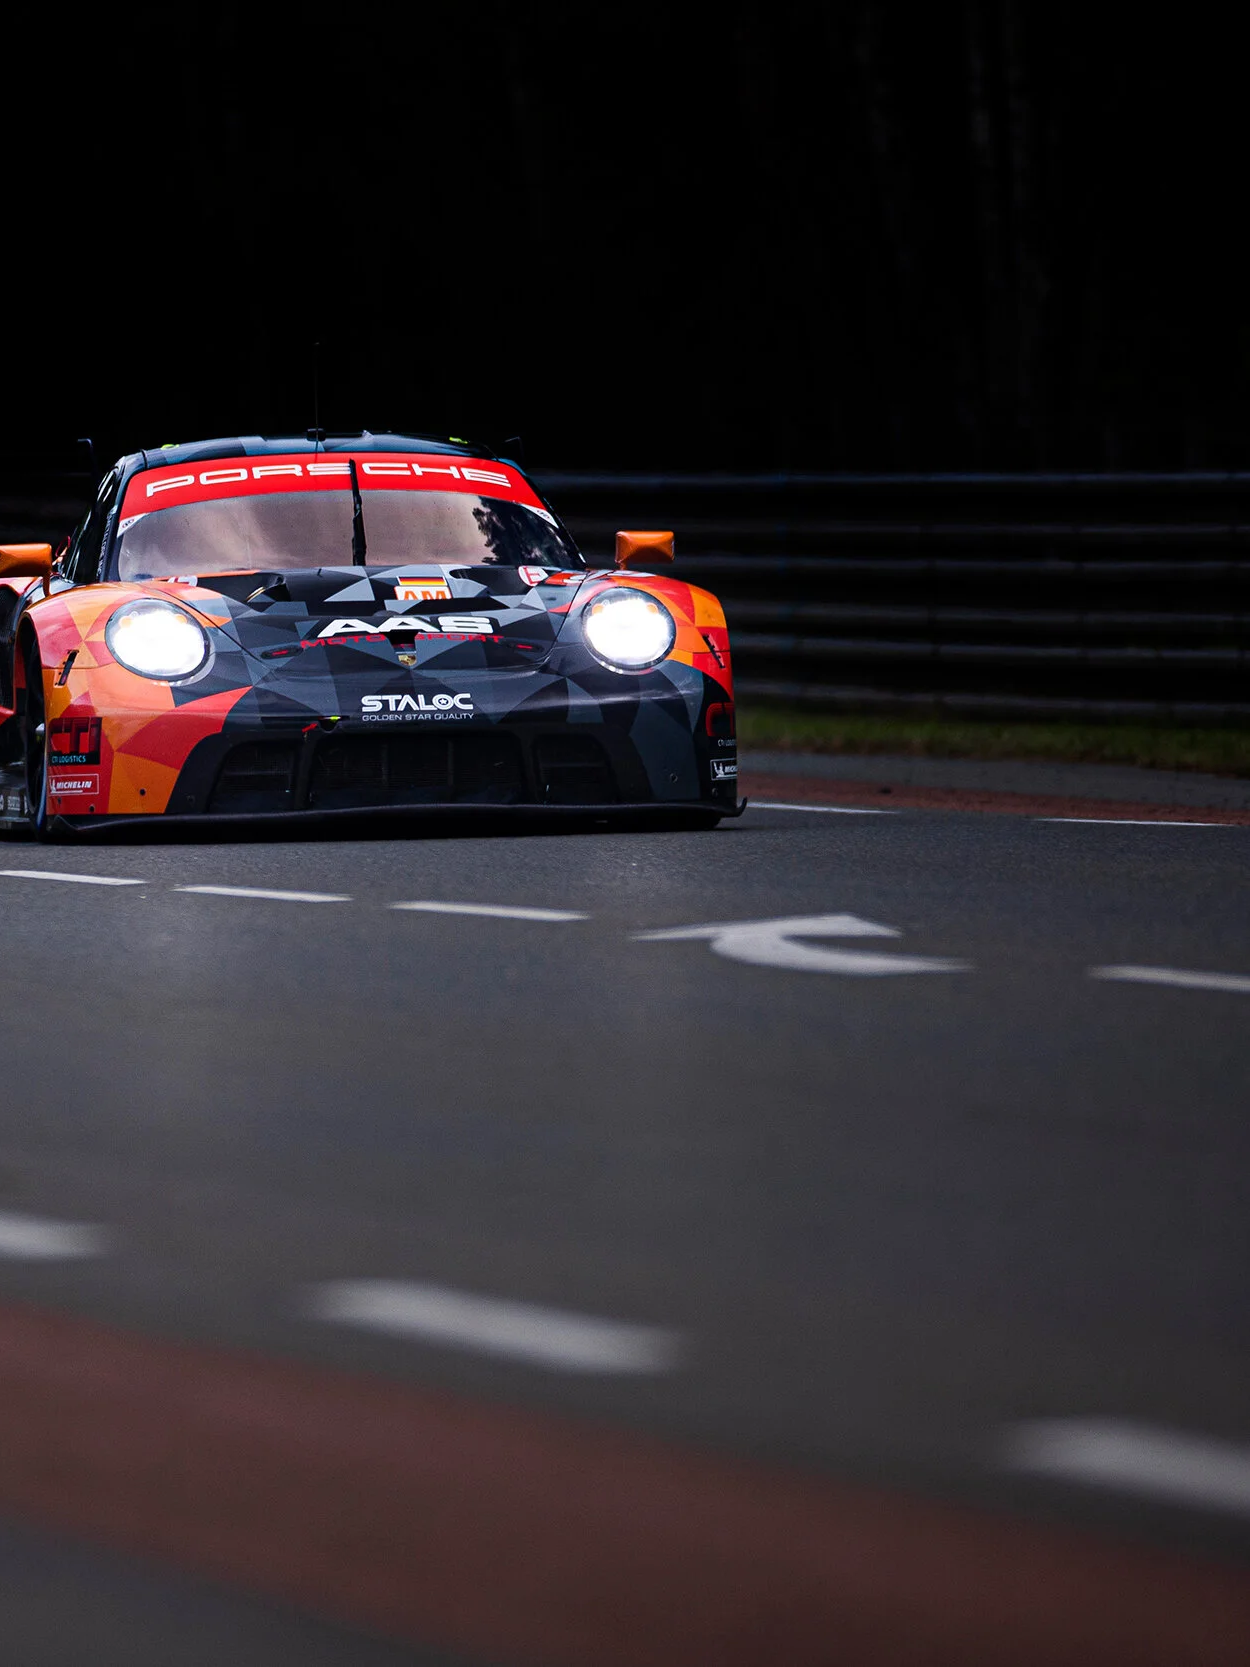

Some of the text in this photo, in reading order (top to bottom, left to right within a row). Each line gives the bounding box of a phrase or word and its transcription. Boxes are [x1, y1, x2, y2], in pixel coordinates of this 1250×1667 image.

[146, 462, 511, 498] PORSCHE
[317, 615, 494, 638] AAS
[361, 693, 474, 713] STALOC
[362, 712, 474, 722] GOLDEN STAR QUALITY
[56, 781, 93, 789] MICHELIN
